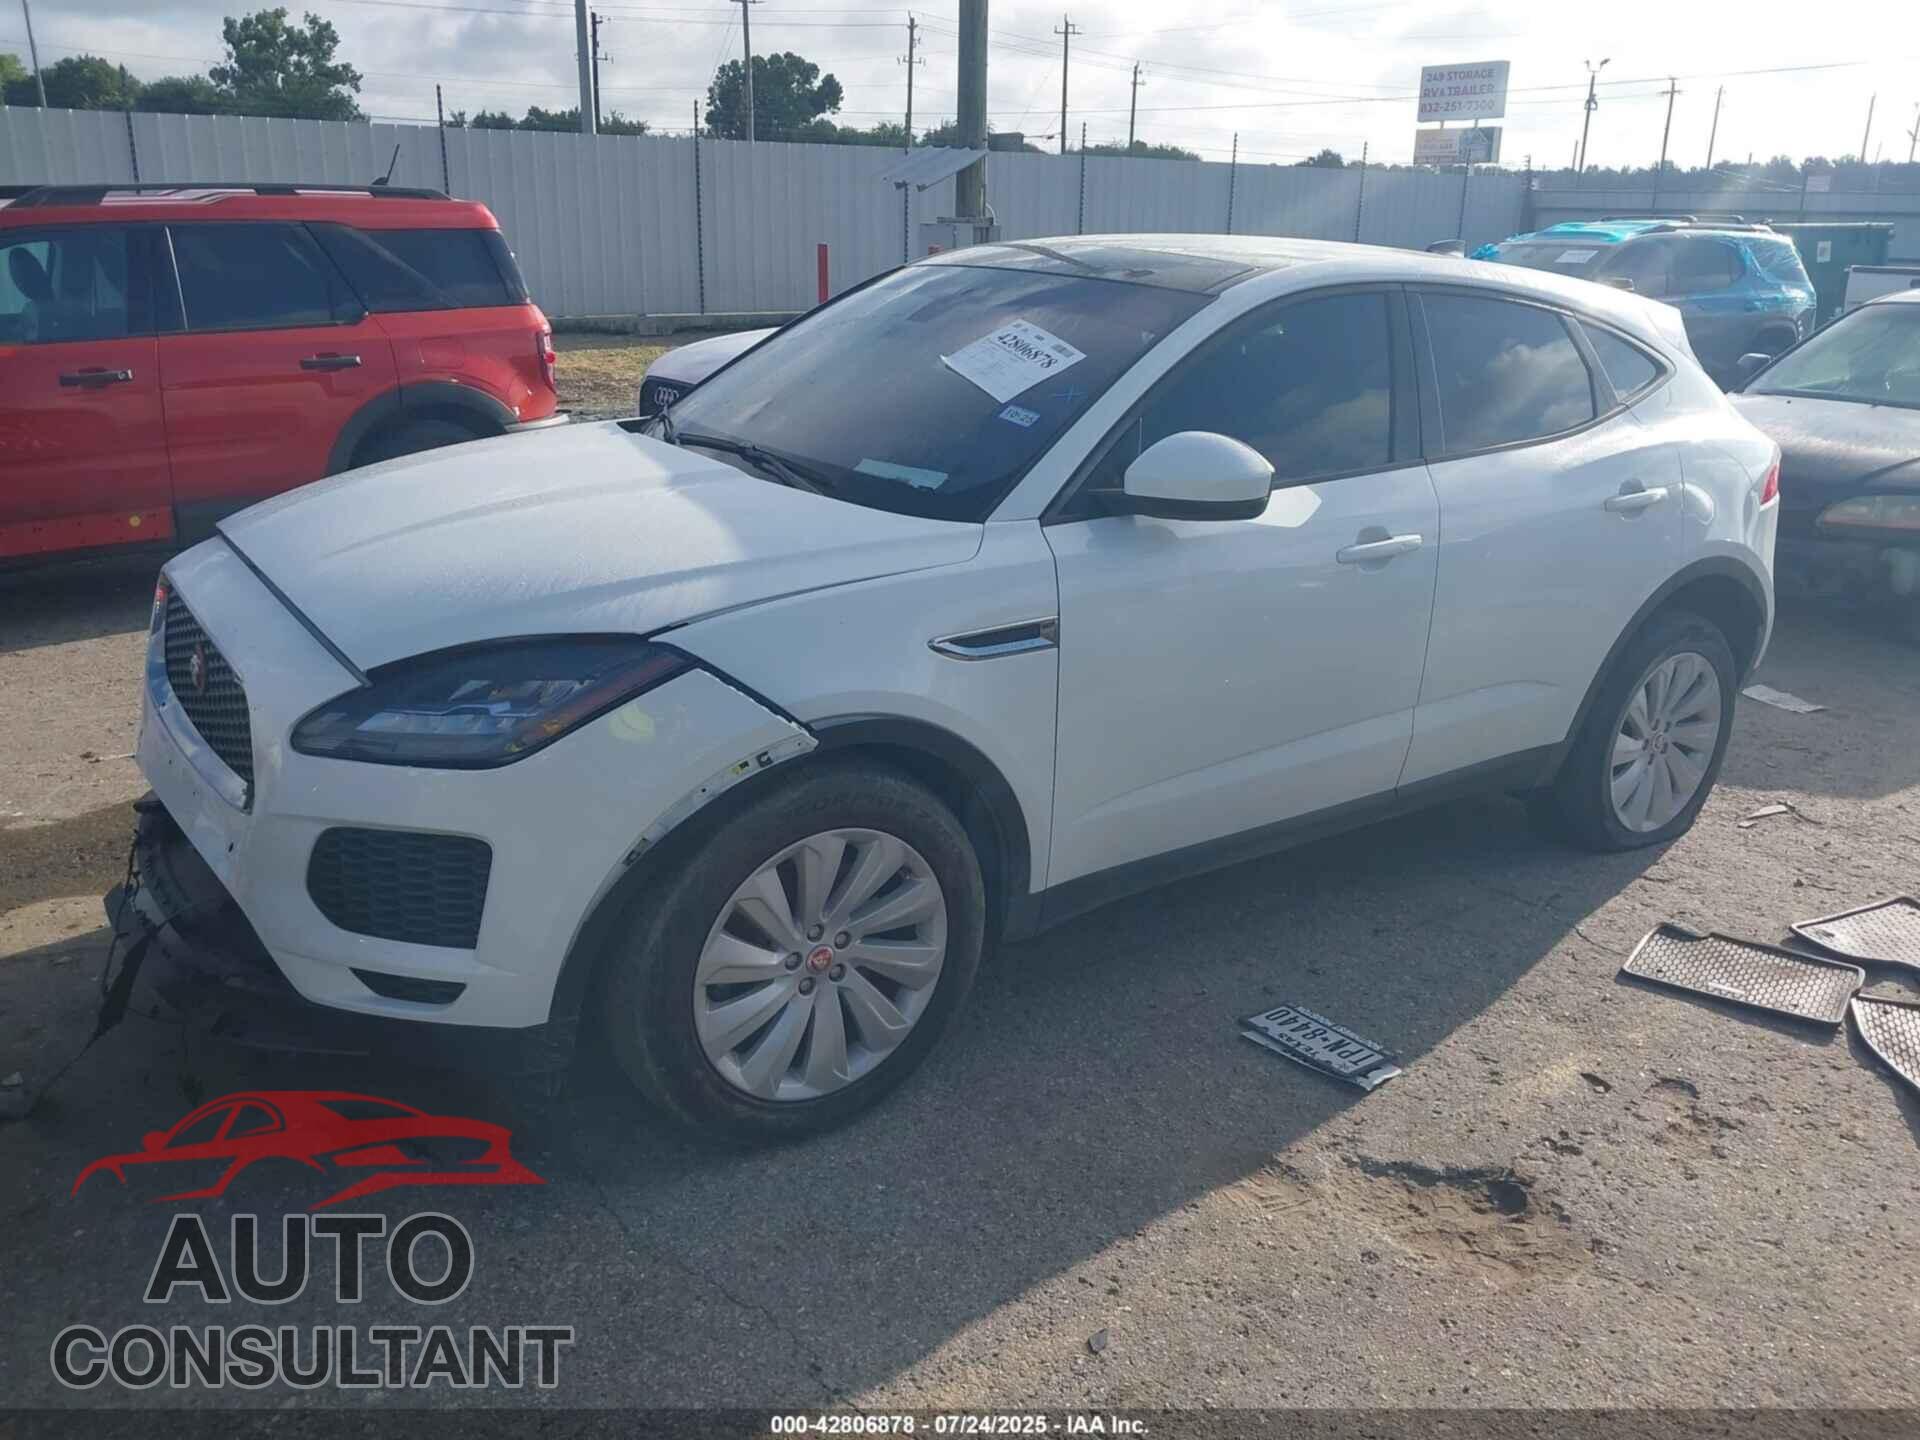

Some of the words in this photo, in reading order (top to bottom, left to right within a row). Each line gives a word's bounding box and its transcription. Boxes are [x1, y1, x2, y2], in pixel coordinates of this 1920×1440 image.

[1447, 68, 1495, 81] STORAGE
[998, 333, 1058, 369] 42806878
[1279, 1032, 1320, 1057] TEXAS
